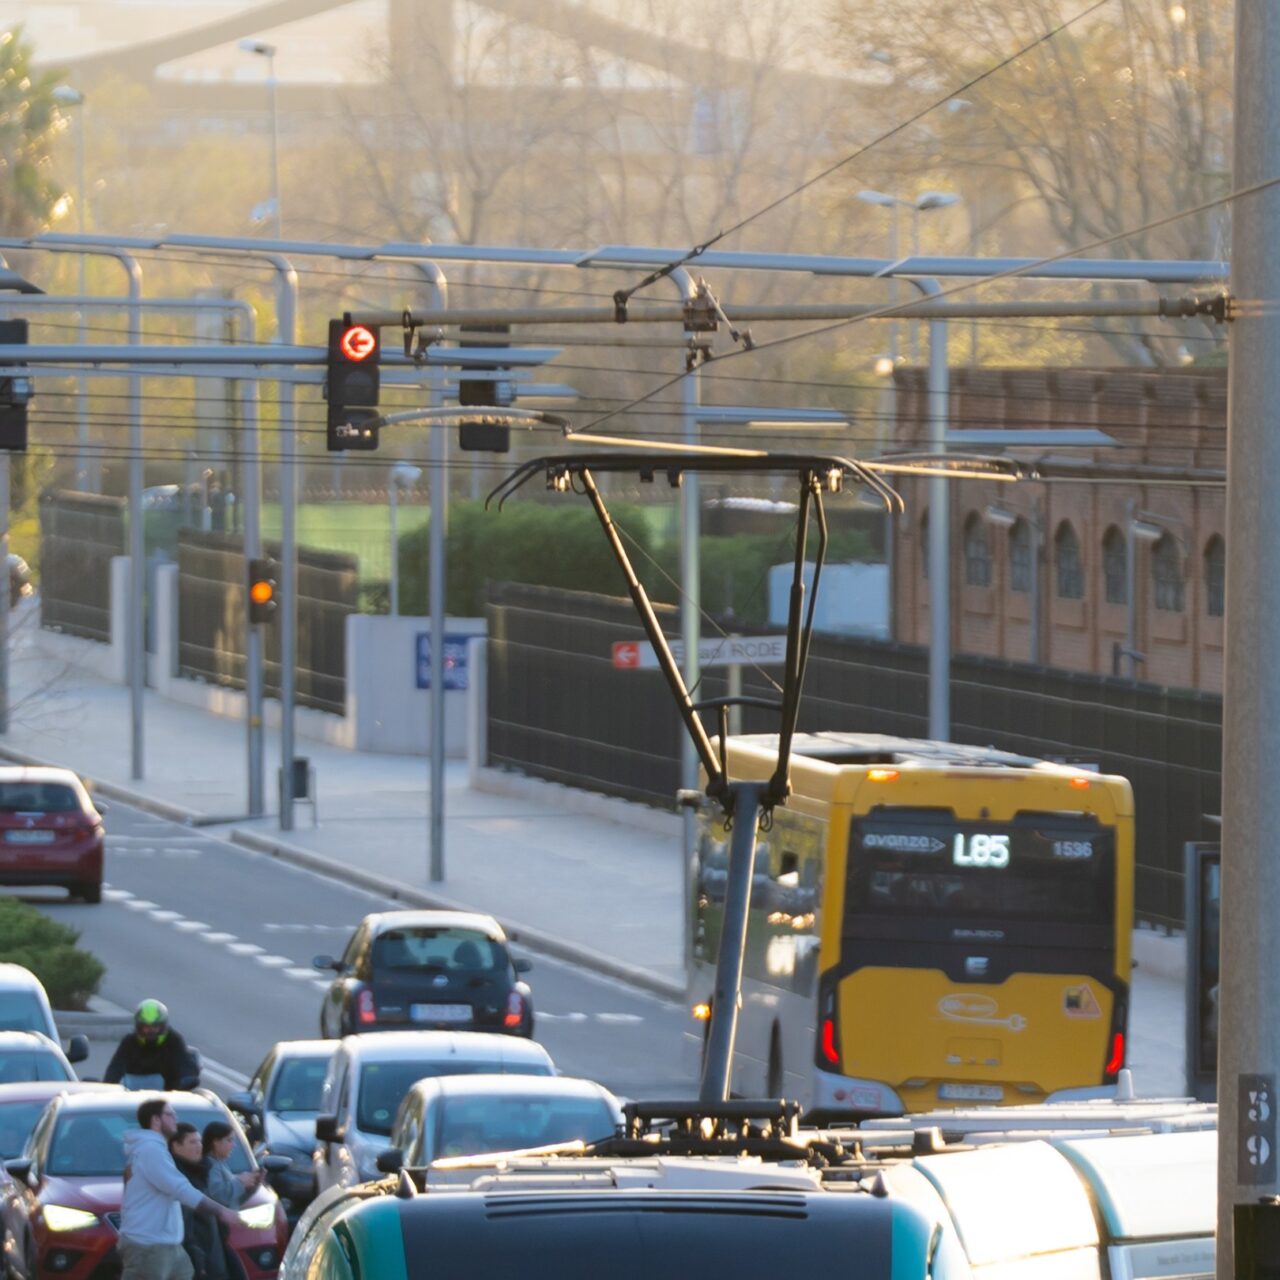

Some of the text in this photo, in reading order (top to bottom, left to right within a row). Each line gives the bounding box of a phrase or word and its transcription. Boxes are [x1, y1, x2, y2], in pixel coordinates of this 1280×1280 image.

[864, 834, 930, 848] avanza
[1054, 841, 1093, 858] 1536
[953, 833, 1010, 868] L85
